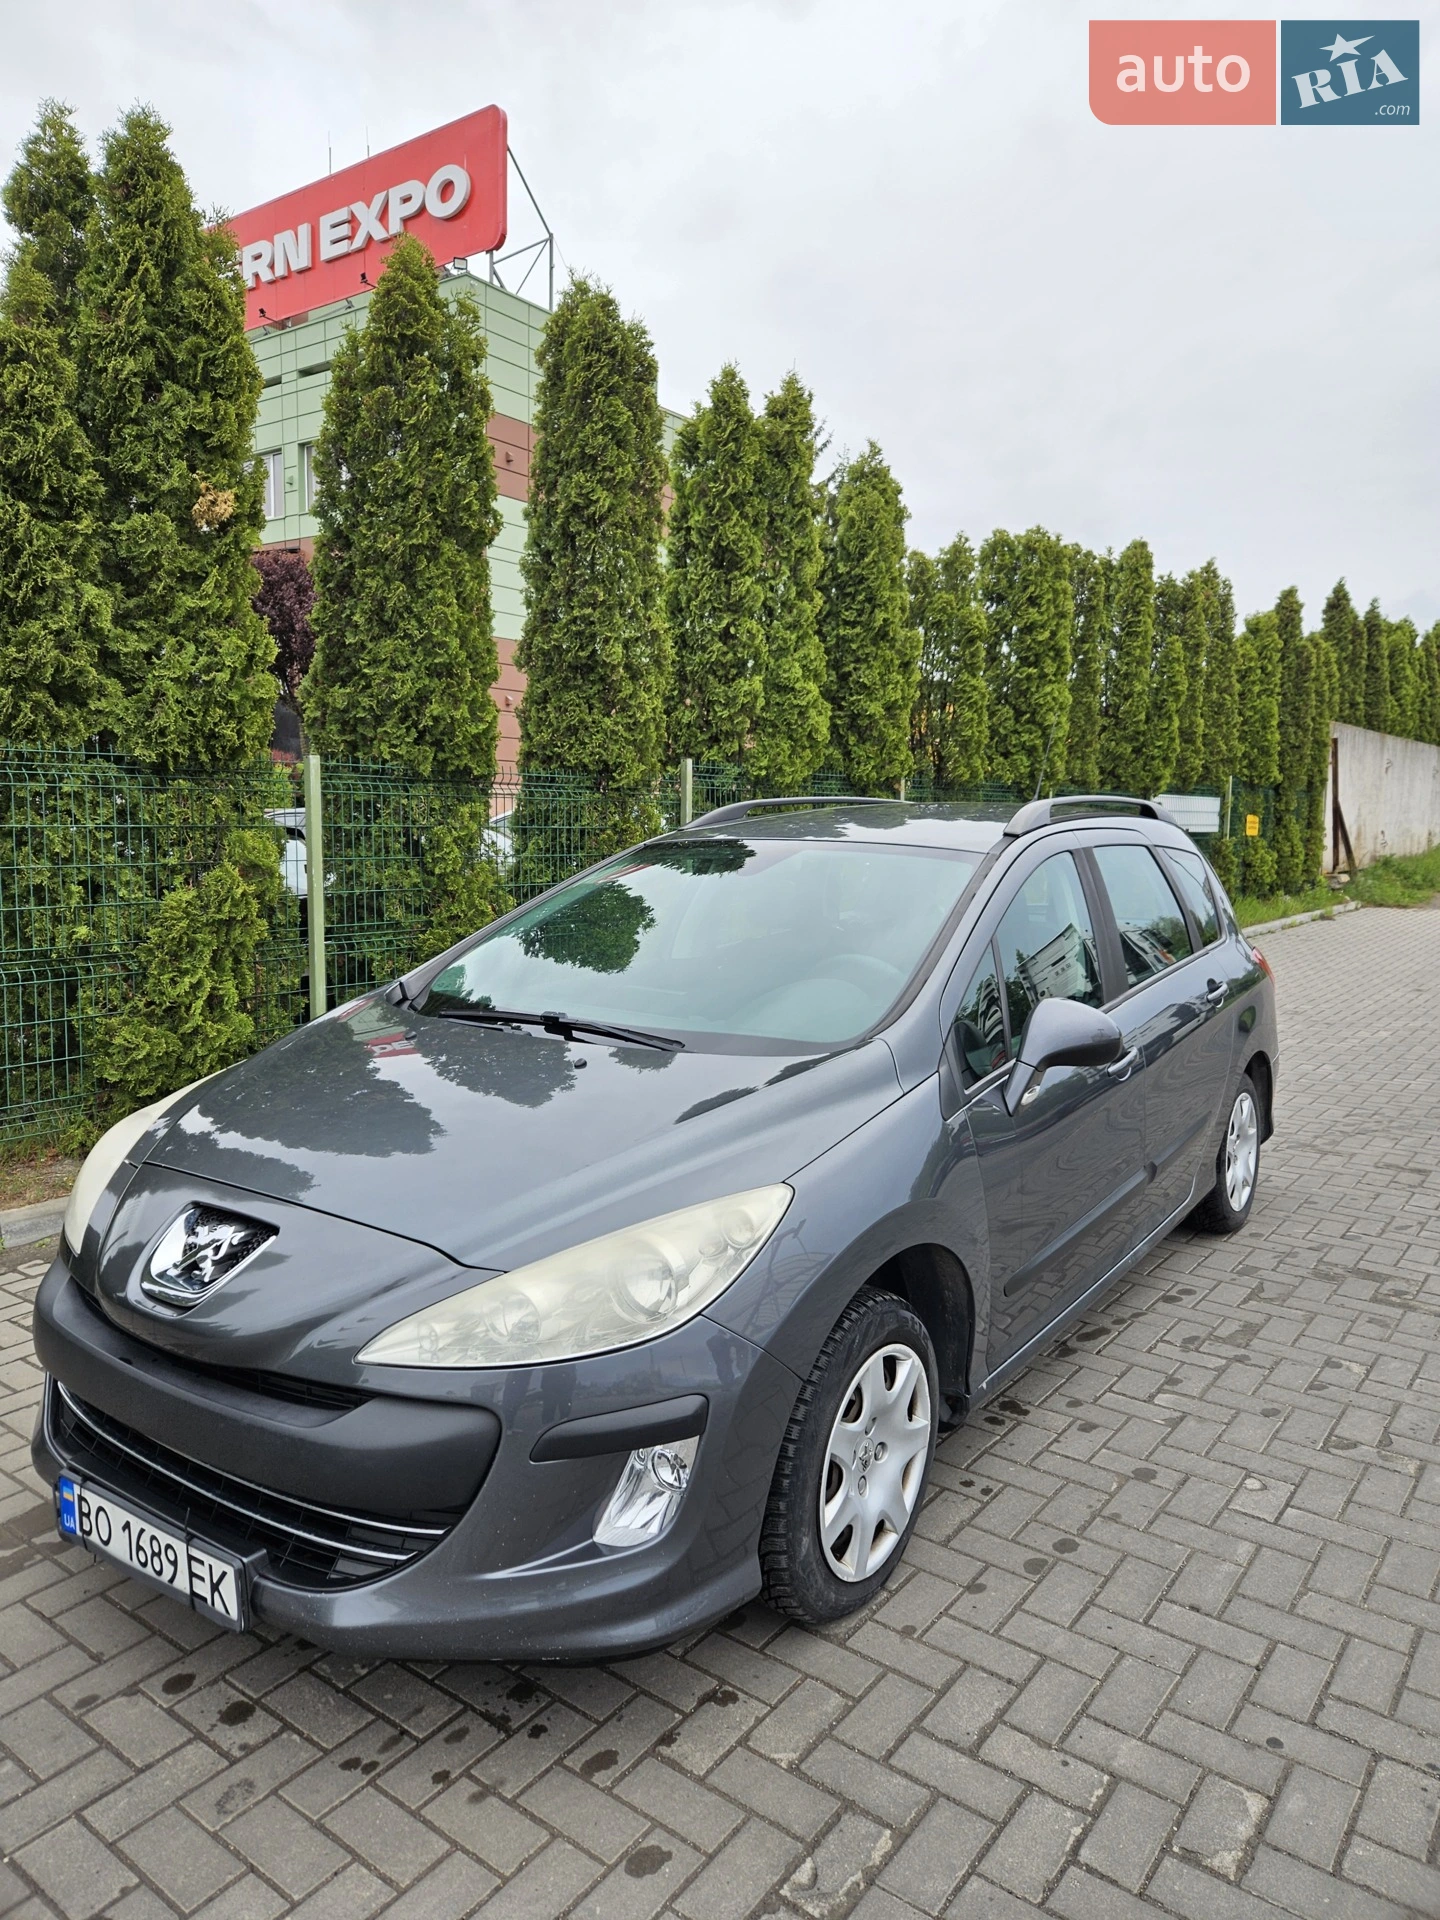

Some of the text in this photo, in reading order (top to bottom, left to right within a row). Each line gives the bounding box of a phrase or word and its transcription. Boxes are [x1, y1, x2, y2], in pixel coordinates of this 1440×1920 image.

[224, 163, 472, 290] RN EXPO
[63, 1513, 76, 1530] UA
[76, 1493, 231, 1616] BO 1689 EK
